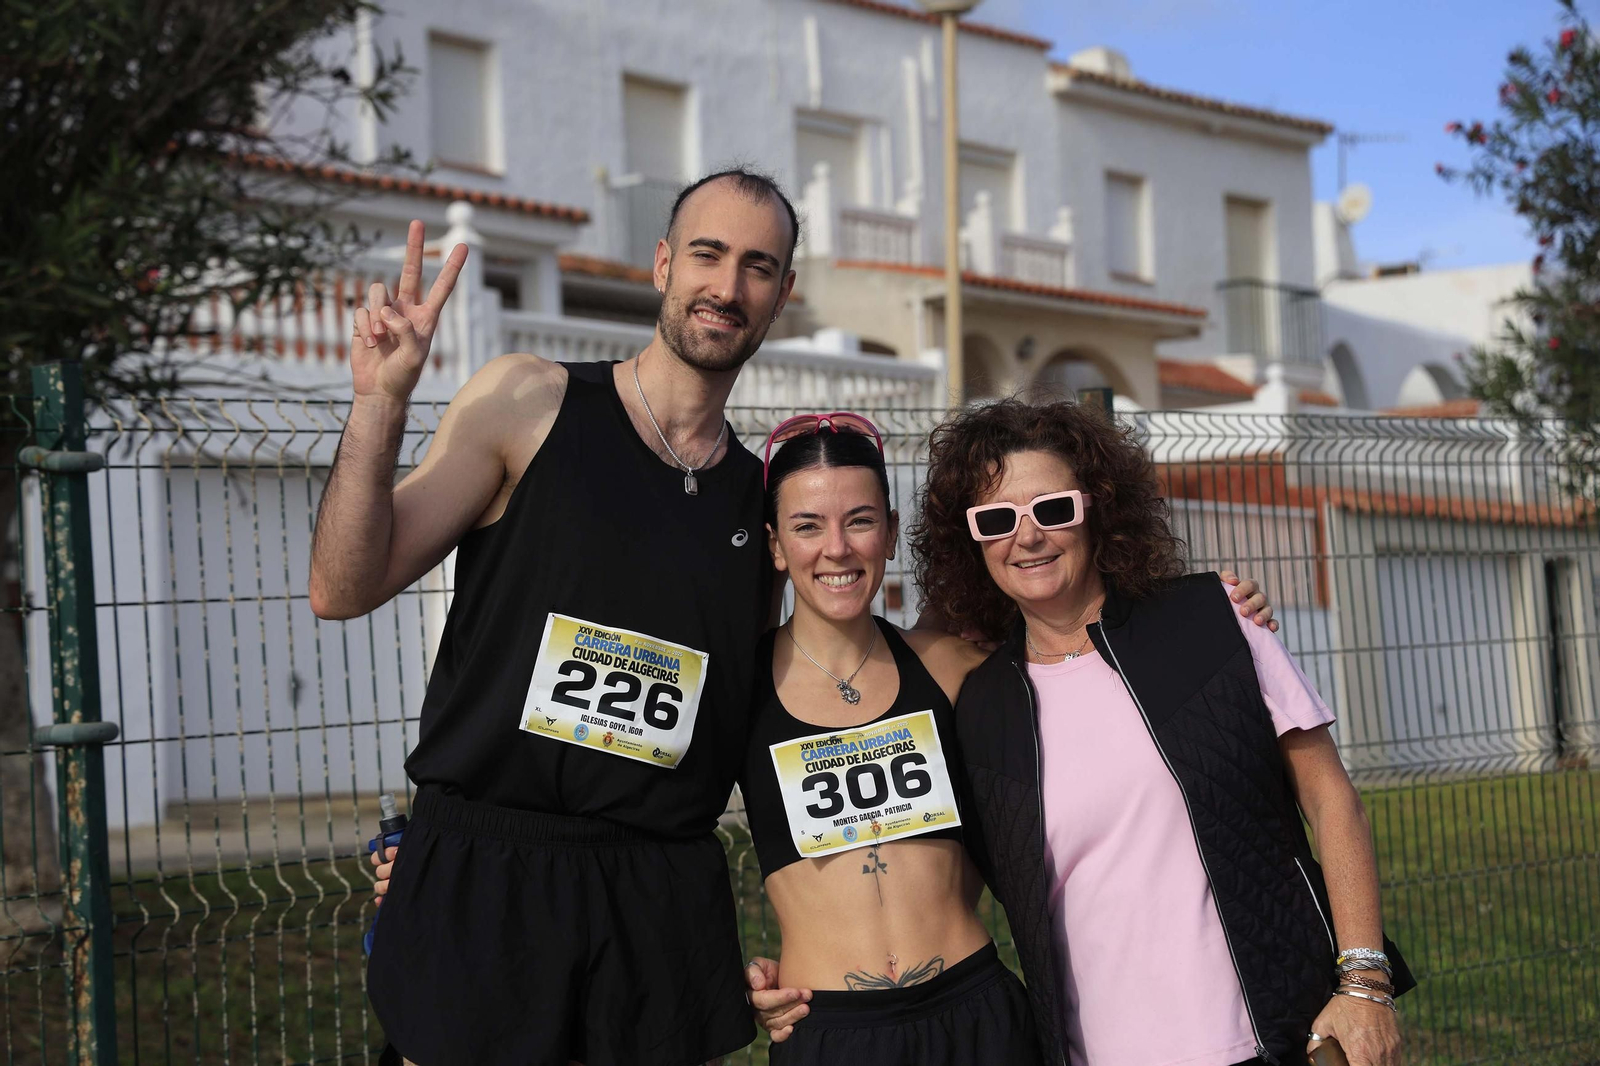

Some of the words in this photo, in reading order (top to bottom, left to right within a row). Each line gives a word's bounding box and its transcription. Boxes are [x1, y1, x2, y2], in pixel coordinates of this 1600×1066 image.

[578, 626, 593, 636] XXV
[594, 629, 621, 642] EDICIÓN
[572, 646, 612, 666] CIUDAD
[613, 656, 628, 670] DE
[628, 661, 679, 684] ALGECIRAS
[574, 633, 631, 657] CARRERA
[633, 647, 680, 671] URBANA
[550, 660, 683, 731] 226
[580, 714, 608, 728] IGLESIAS
[609, 722, 627, 733] GOYA,
[628, 725, 643, 736] IGOR
[617, 738, 643, 748] Ayuntamiento
[800, 742, 814, 750] XXV
[801, 742, 858, 762] CARRERA
[859, 728, 913, 750] URBANA
[805, 756, 845, 773] CIUDAD
[847, 753, 861, 766] DE
[862, 740, 916, 763] ALGECIRAS
[802, 752, 932, 819] 306
[833, 815, 858, 828] MONTES
[885, 803, 912, 815] PATRICIA
[885, 817, 911, 826] Ayuntamiento
